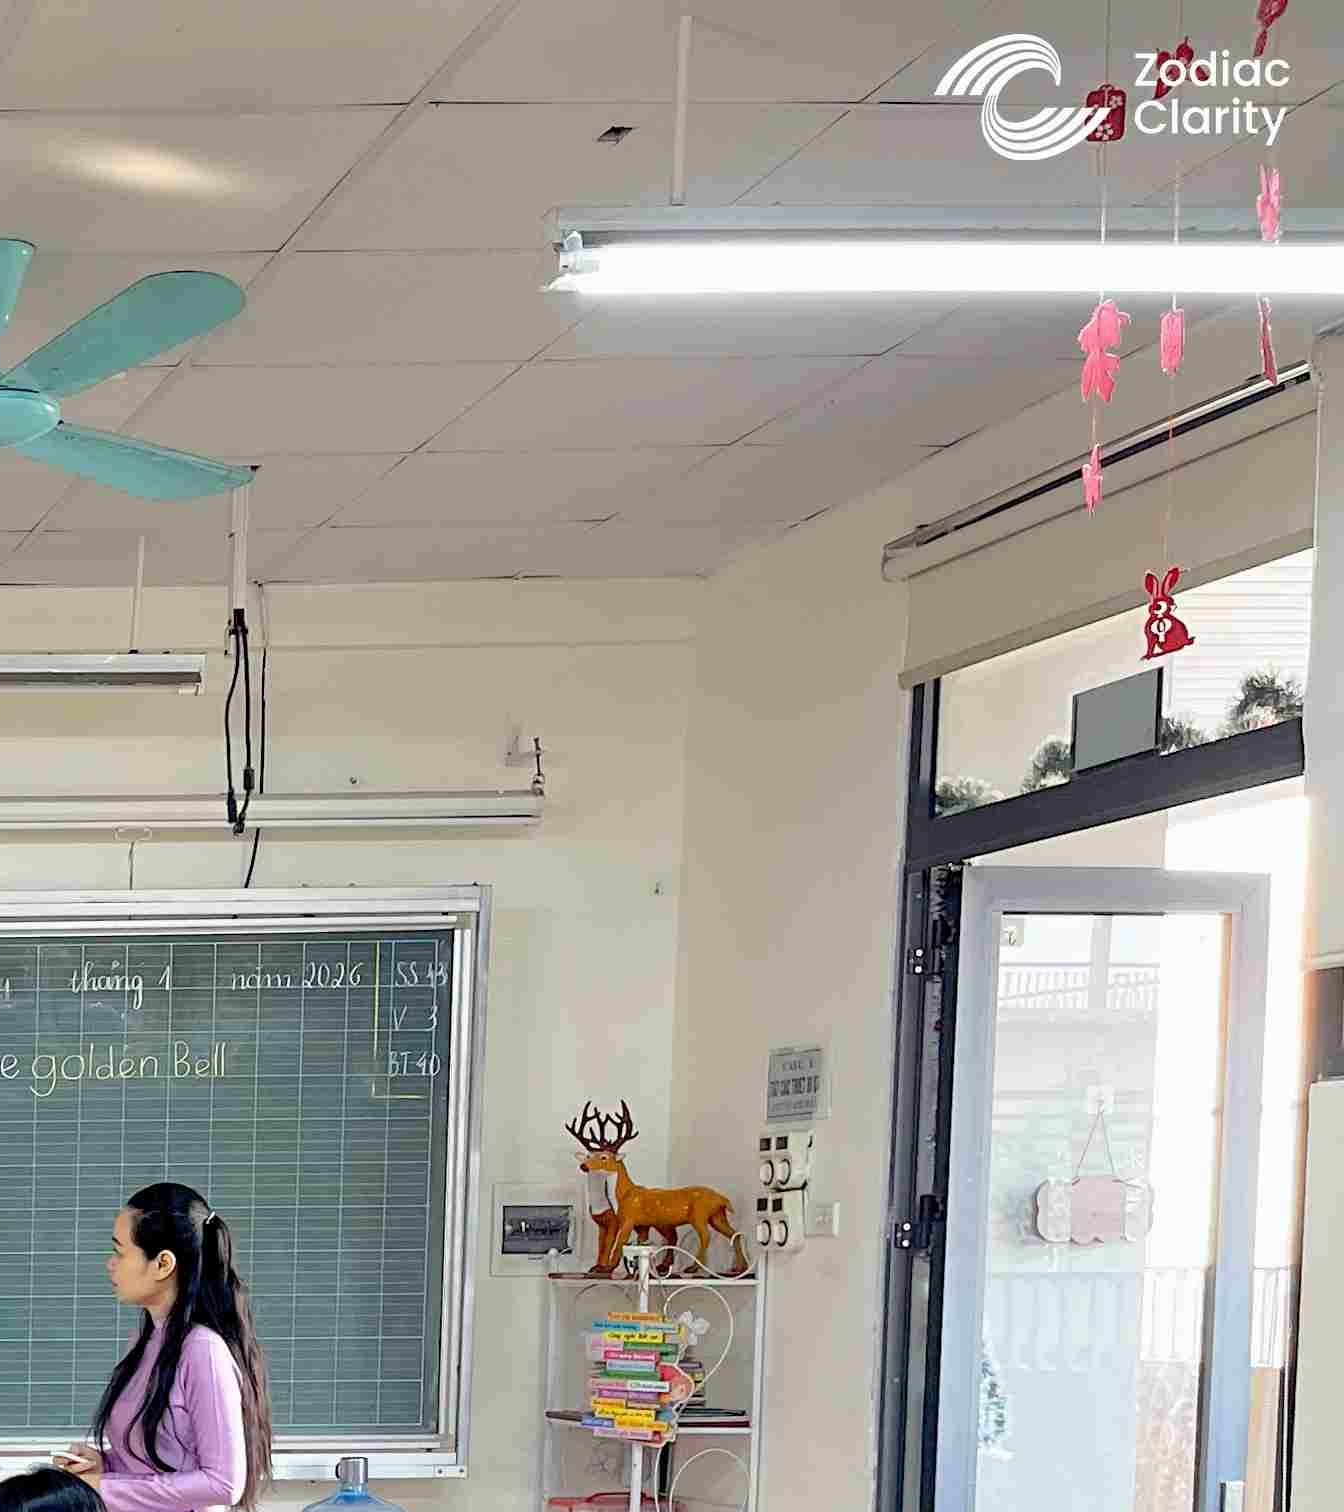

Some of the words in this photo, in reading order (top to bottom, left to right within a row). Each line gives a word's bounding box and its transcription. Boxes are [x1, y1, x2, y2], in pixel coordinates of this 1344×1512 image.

[158, 965, 171, 991] 1
[303, 962, 364, 989] 2026
[29, 1042, 159, 1097] golden
[173, 1040, 227, 1079] Bell
